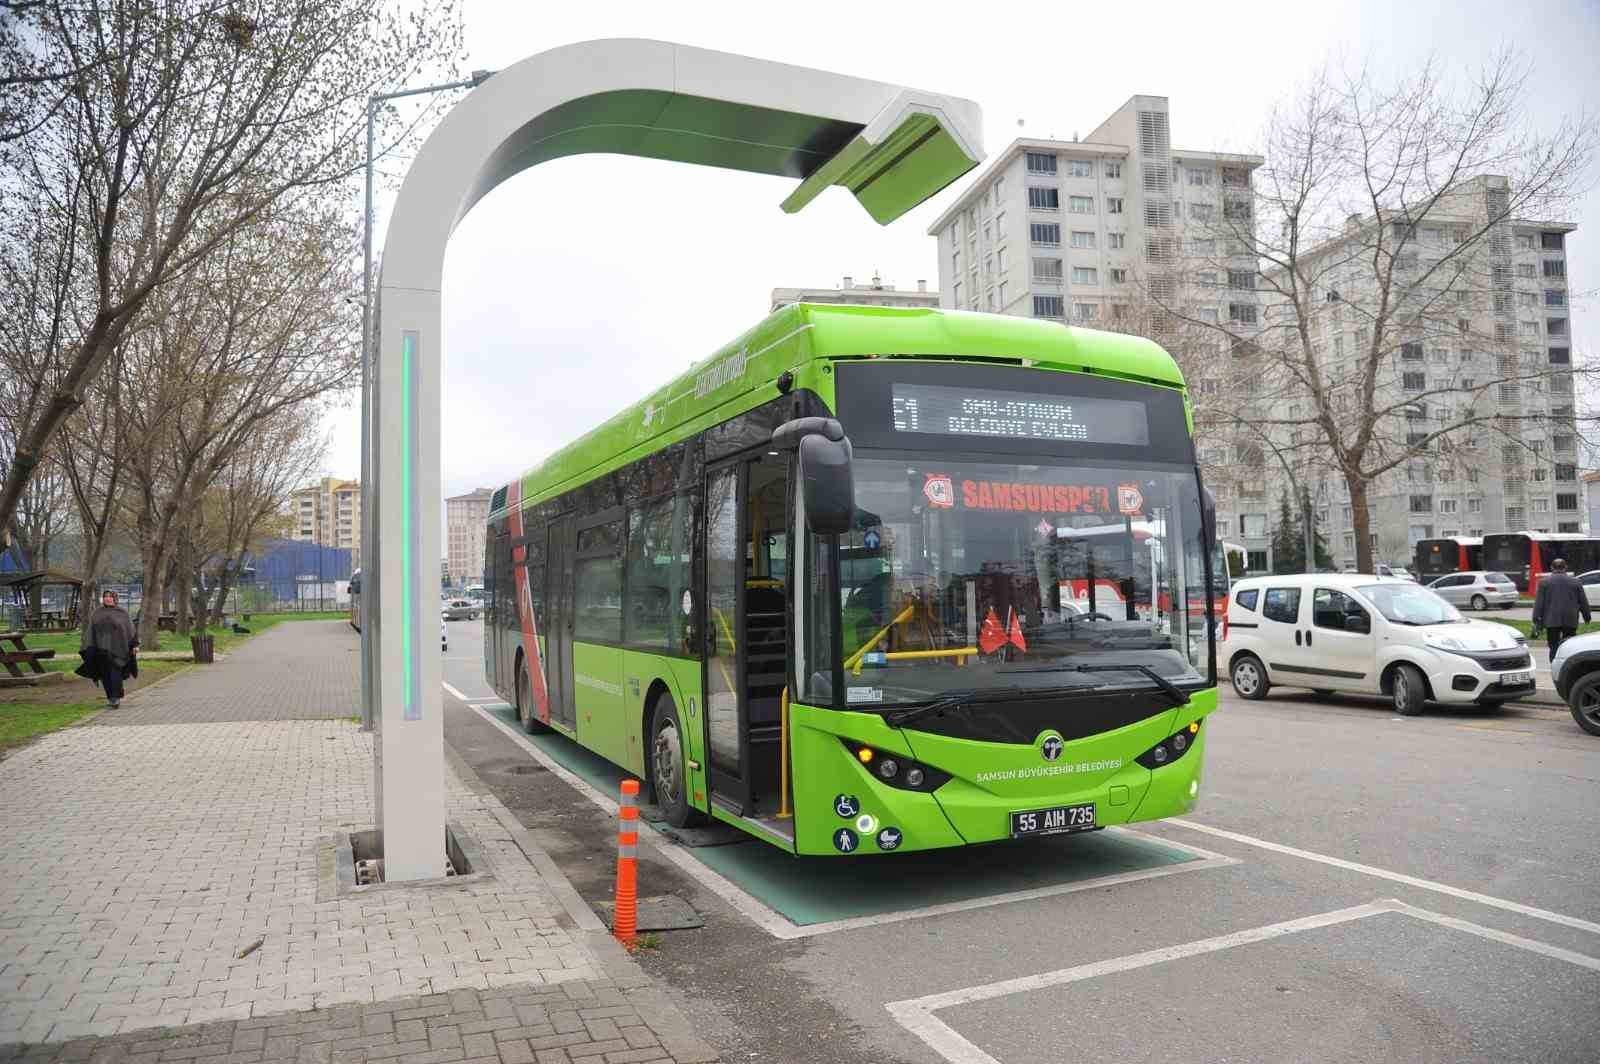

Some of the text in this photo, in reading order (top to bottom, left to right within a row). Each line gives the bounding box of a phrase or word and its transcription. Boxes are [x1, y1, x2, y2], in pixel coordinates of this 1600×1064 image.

[892, 398, 918, 429] E1
[976, 771, 1016, 783] SAMSUN
[1019, 806, 1093, 831] 55 AIH 735
